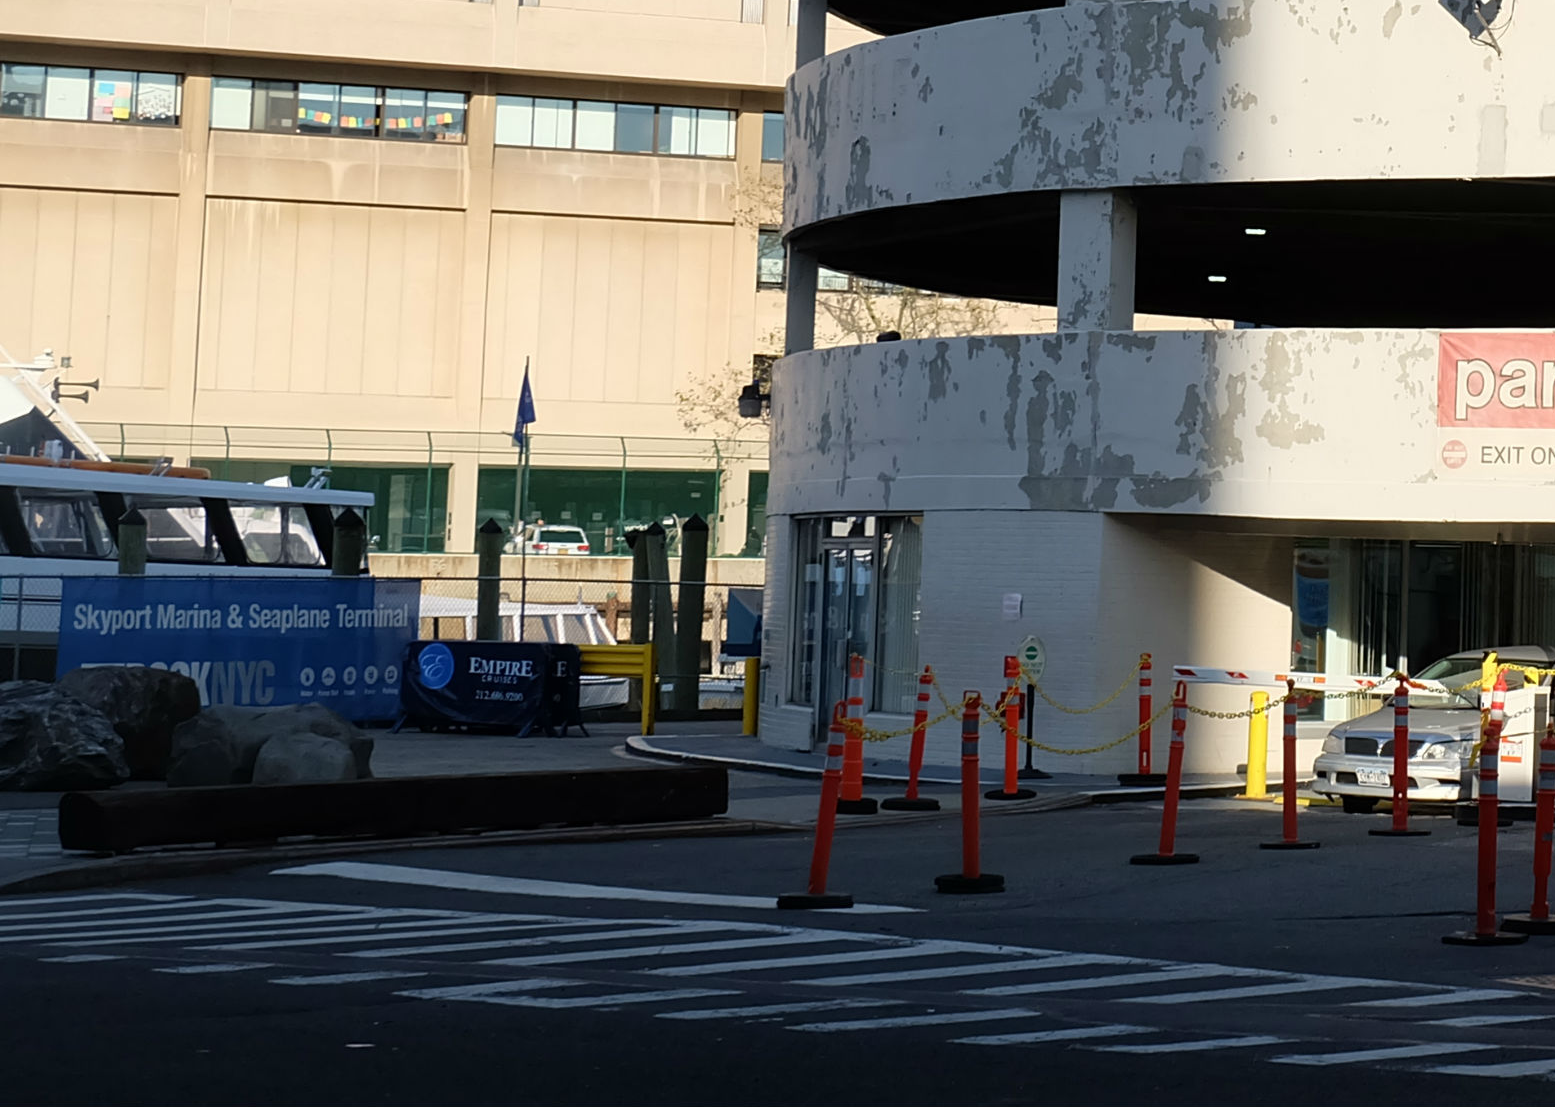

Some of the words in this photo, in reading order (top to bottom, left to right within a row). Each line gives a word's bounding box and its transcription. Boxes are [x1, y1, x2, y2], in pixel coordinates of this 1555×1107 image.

[1481, 446, 1525, 464] EXIT
[73, 604, 152, 635] Skyport
[157, 604, 222, 630] Marina
[227, 604, 243, 630] &
[248, 603, 331, 634] Seaplane
[336, 603, 409, 629] Terminal
[468, 656, 533, 677] EMPIRE
[481, 674, 518, 685] CRUISES
